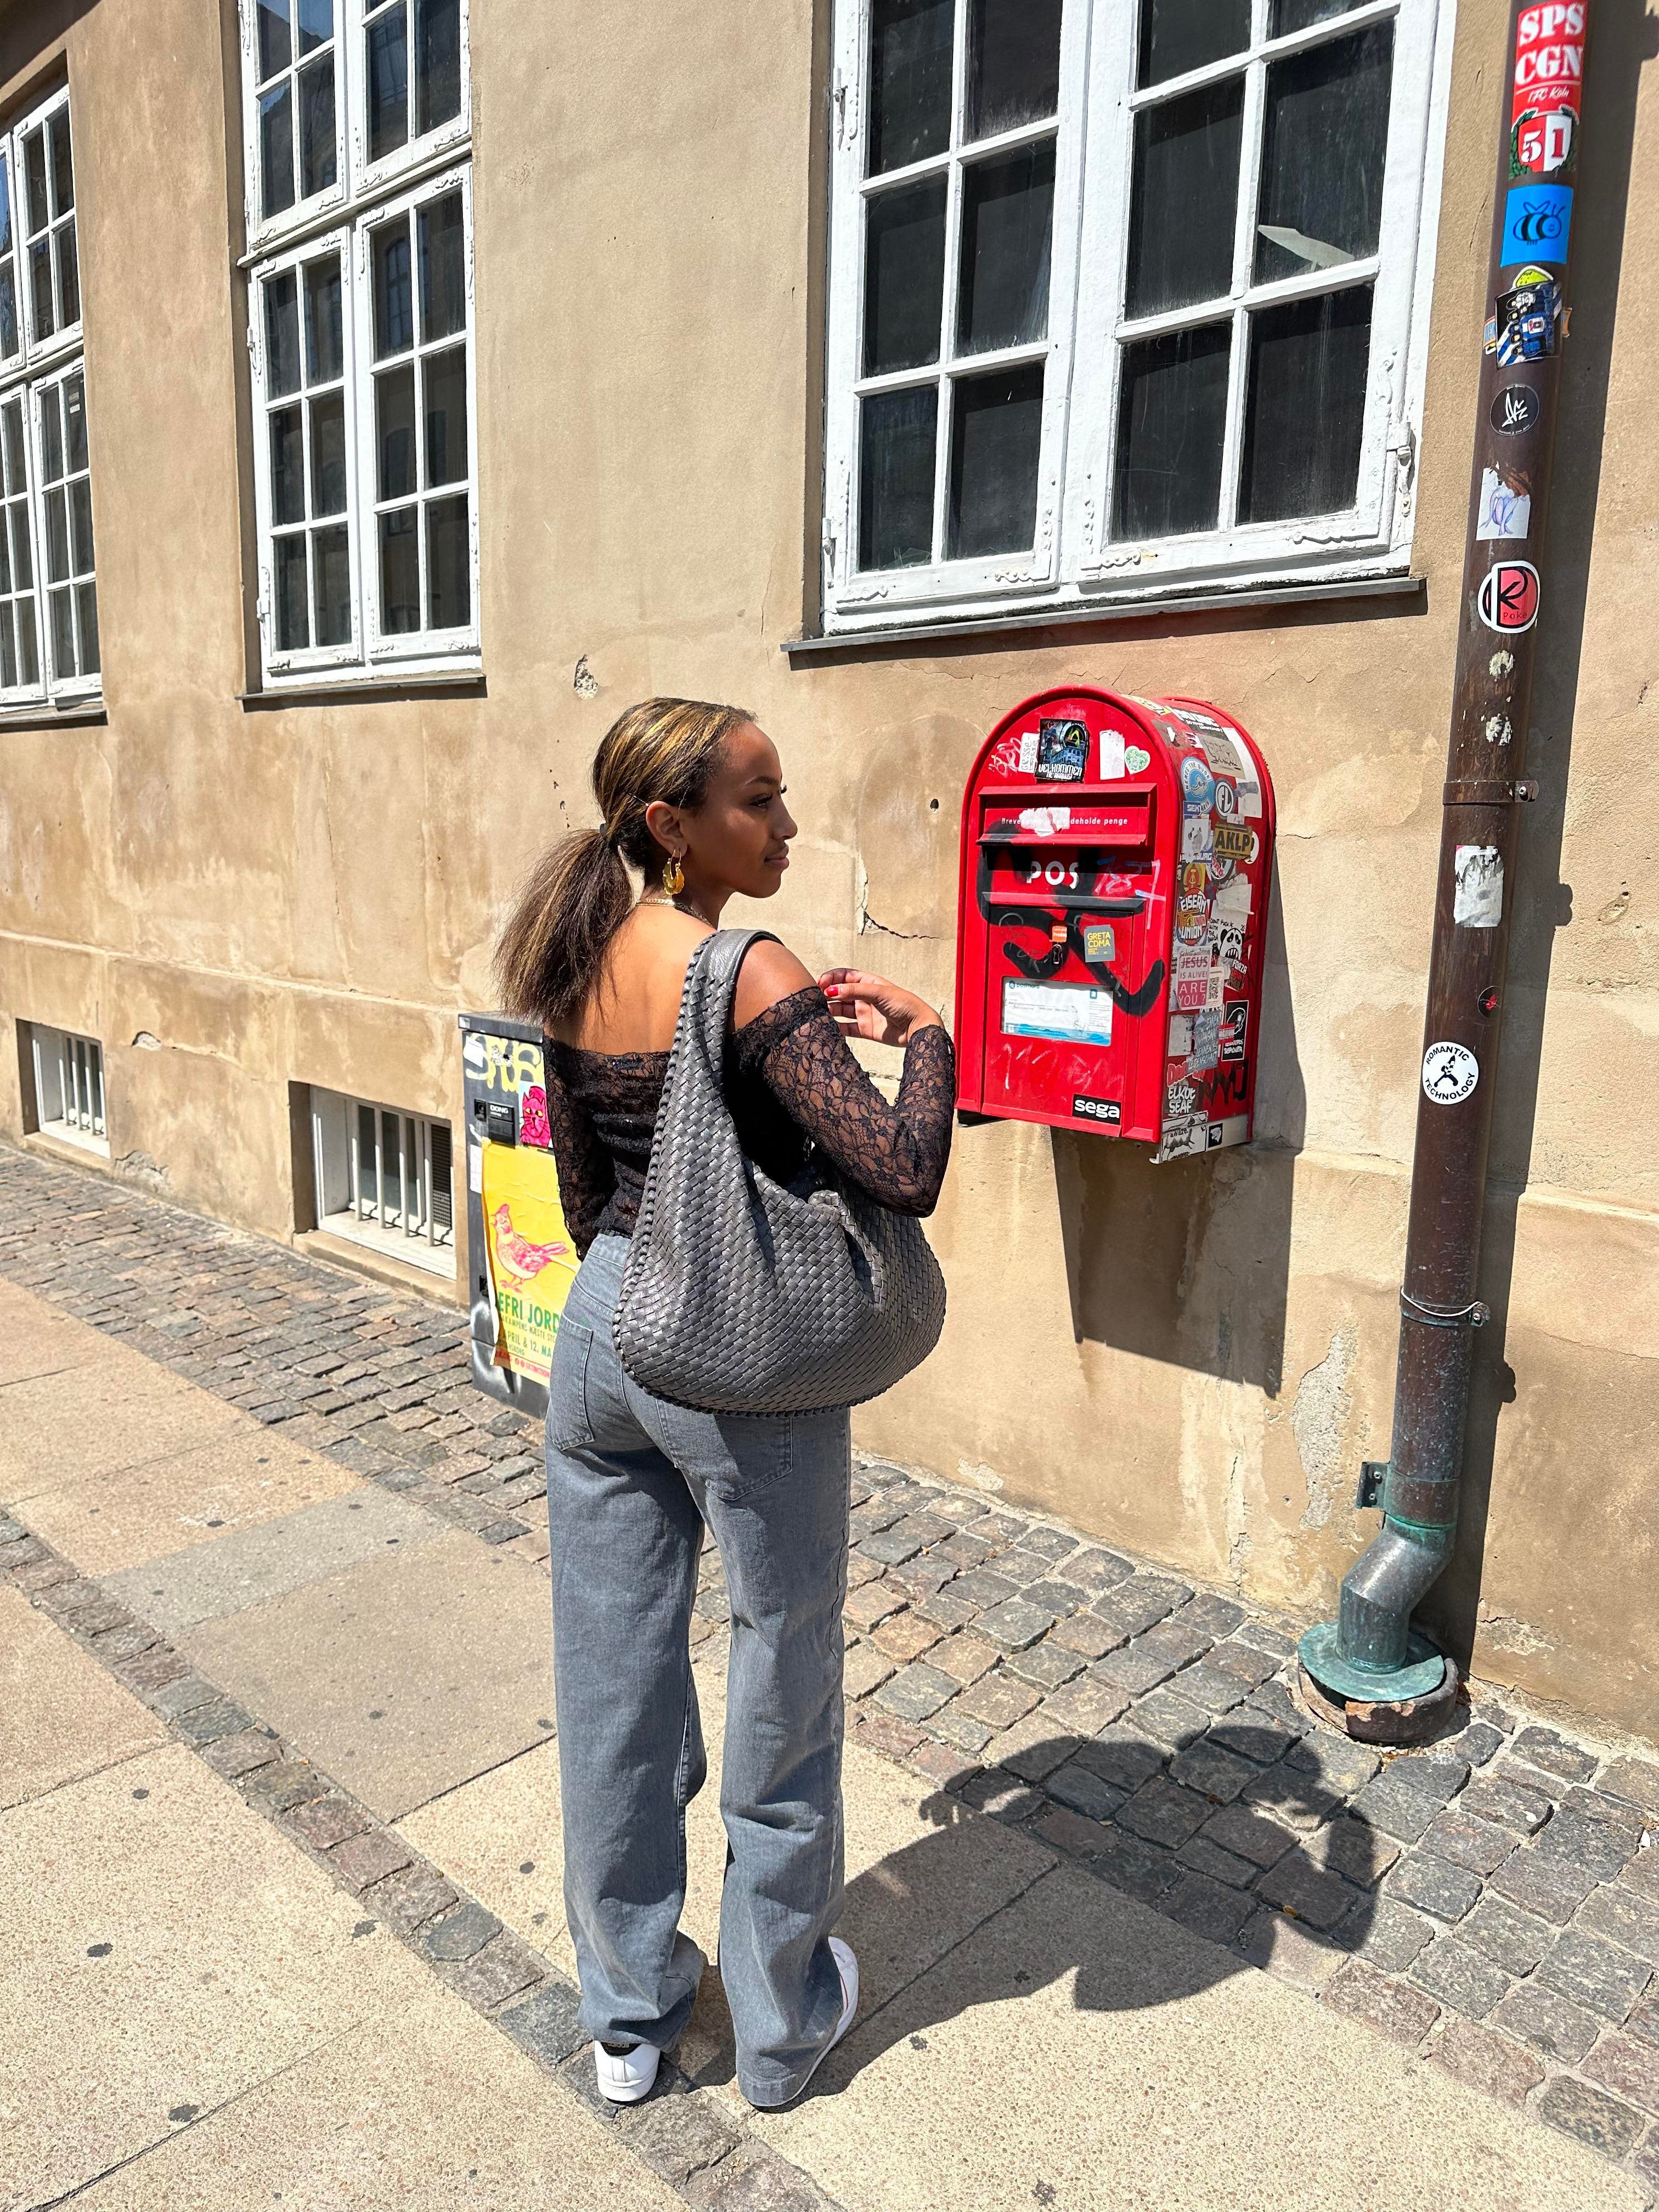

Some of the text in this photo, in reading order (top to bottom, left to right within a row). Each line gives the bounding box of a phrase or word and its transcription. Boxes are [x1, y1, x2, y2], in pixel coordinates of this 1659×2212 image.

[1519, 3, 1584, 47] SPS
[1515, 45, 1584, 85] CGN
[1520, 127, 1565, 163] 51
[1038, 763, 1082, 777] VELKOMMEN
[1103, 818, 1128, 826] penge
[1214, 830, 1251, 853] AKLP
[1026, 861, 1080, 890] POS
[1180, 894, 1207, 913] EISERN
[1087, 932, 1111, 940] GRETA
[1181, 925, 1203, 939] UNION
[1180, 956, 1208, 969] JESUS
[1232, 959, 1248, 975] FORZA
[1179, 981, 1206, 995] ARE
[1178, 994, 1198, 1006] YOU
[1426, 1046, 1470, 1065] ROMANTIC
[1425, 1072, 1476, 1100] TECHNOLOGY
[1074, 1099, 1120, 1119] sega
[1169, 1099, 1193, 1114] SEAF
[498, 1291, 523, 1321] EFRI
[523, 1338, 528, 1349] &
